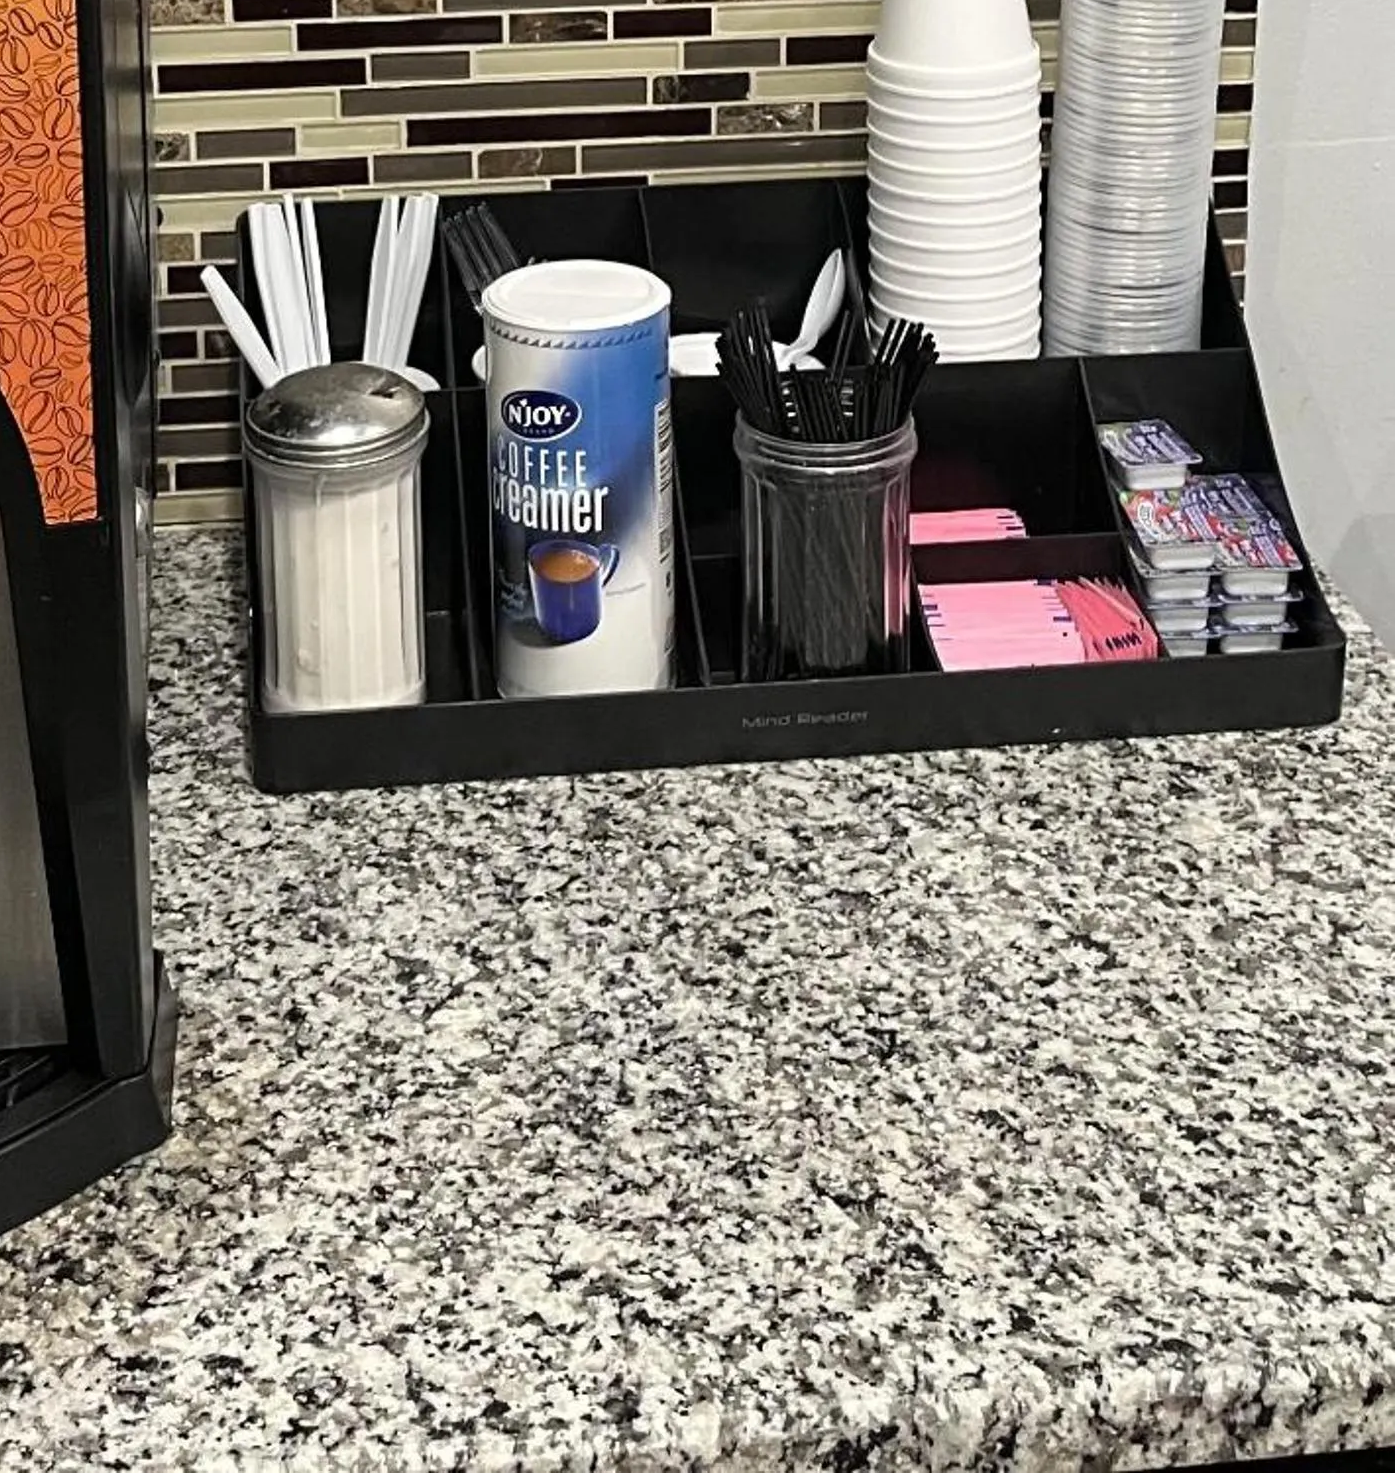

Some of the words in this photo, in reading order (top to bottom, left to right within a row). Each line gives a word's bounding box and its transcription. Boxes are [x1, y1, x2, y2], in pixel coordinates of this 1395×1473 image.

[508, 399, 567, 427] N'JOY
[497, 434, 587, 487] COFFEE
[492, 467, 609, 533] creamer
[742, 714, 791, 728] Mind
